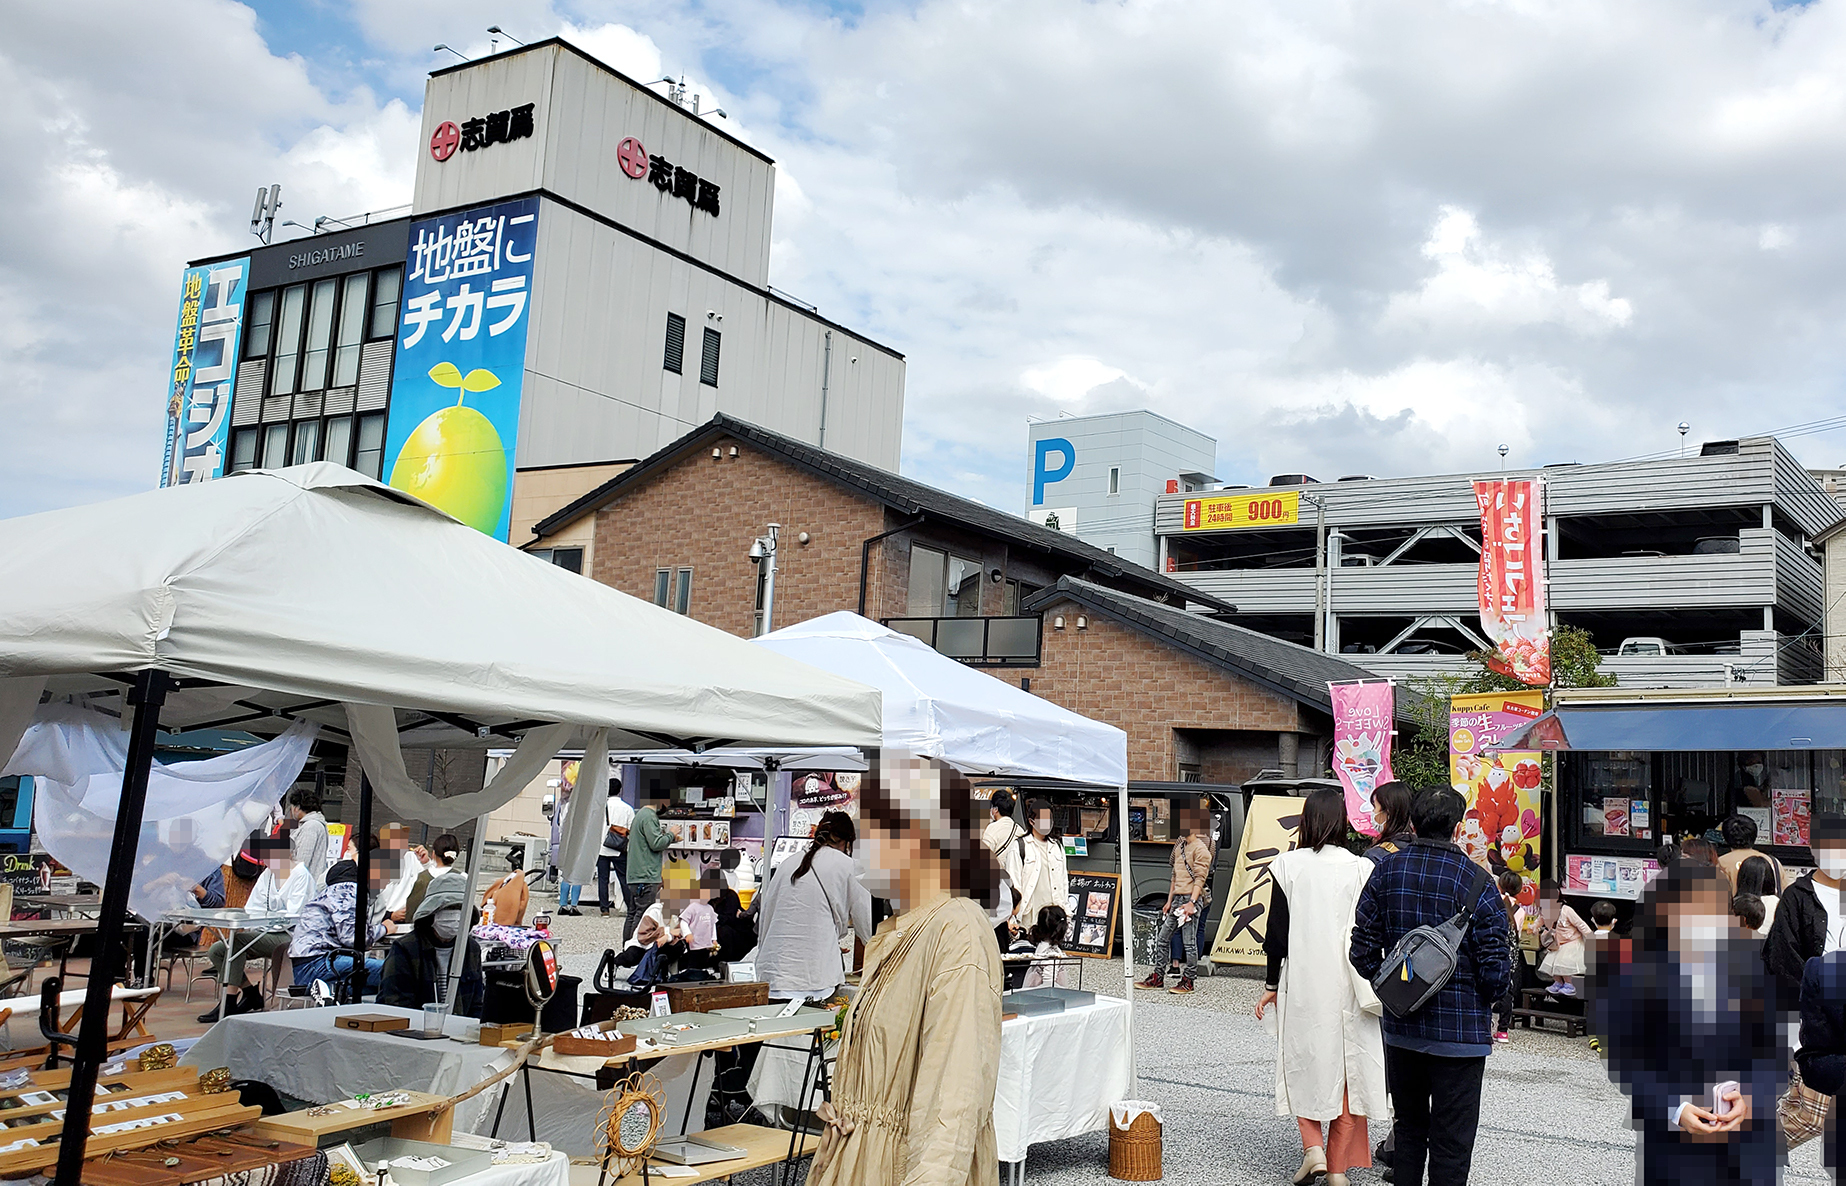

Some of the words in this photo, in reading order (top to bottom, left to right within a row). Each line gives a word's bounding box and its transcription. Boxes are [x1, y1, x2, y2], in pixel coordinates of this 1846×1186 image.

[288, 241, 366, 270] SHIGATAME
[409, 213, 535, 284] 地盤に
[174, 272, 202, 384] 地盤革命
[403, 275, 528, 349] チカラ
[1033, 437, 1076, 506] P
[1207, 512, 1233, 523] 24時間
[1208, 502, 1233, 513] 駐車後
[1215, 946, 1246, 956] MIKAWA
